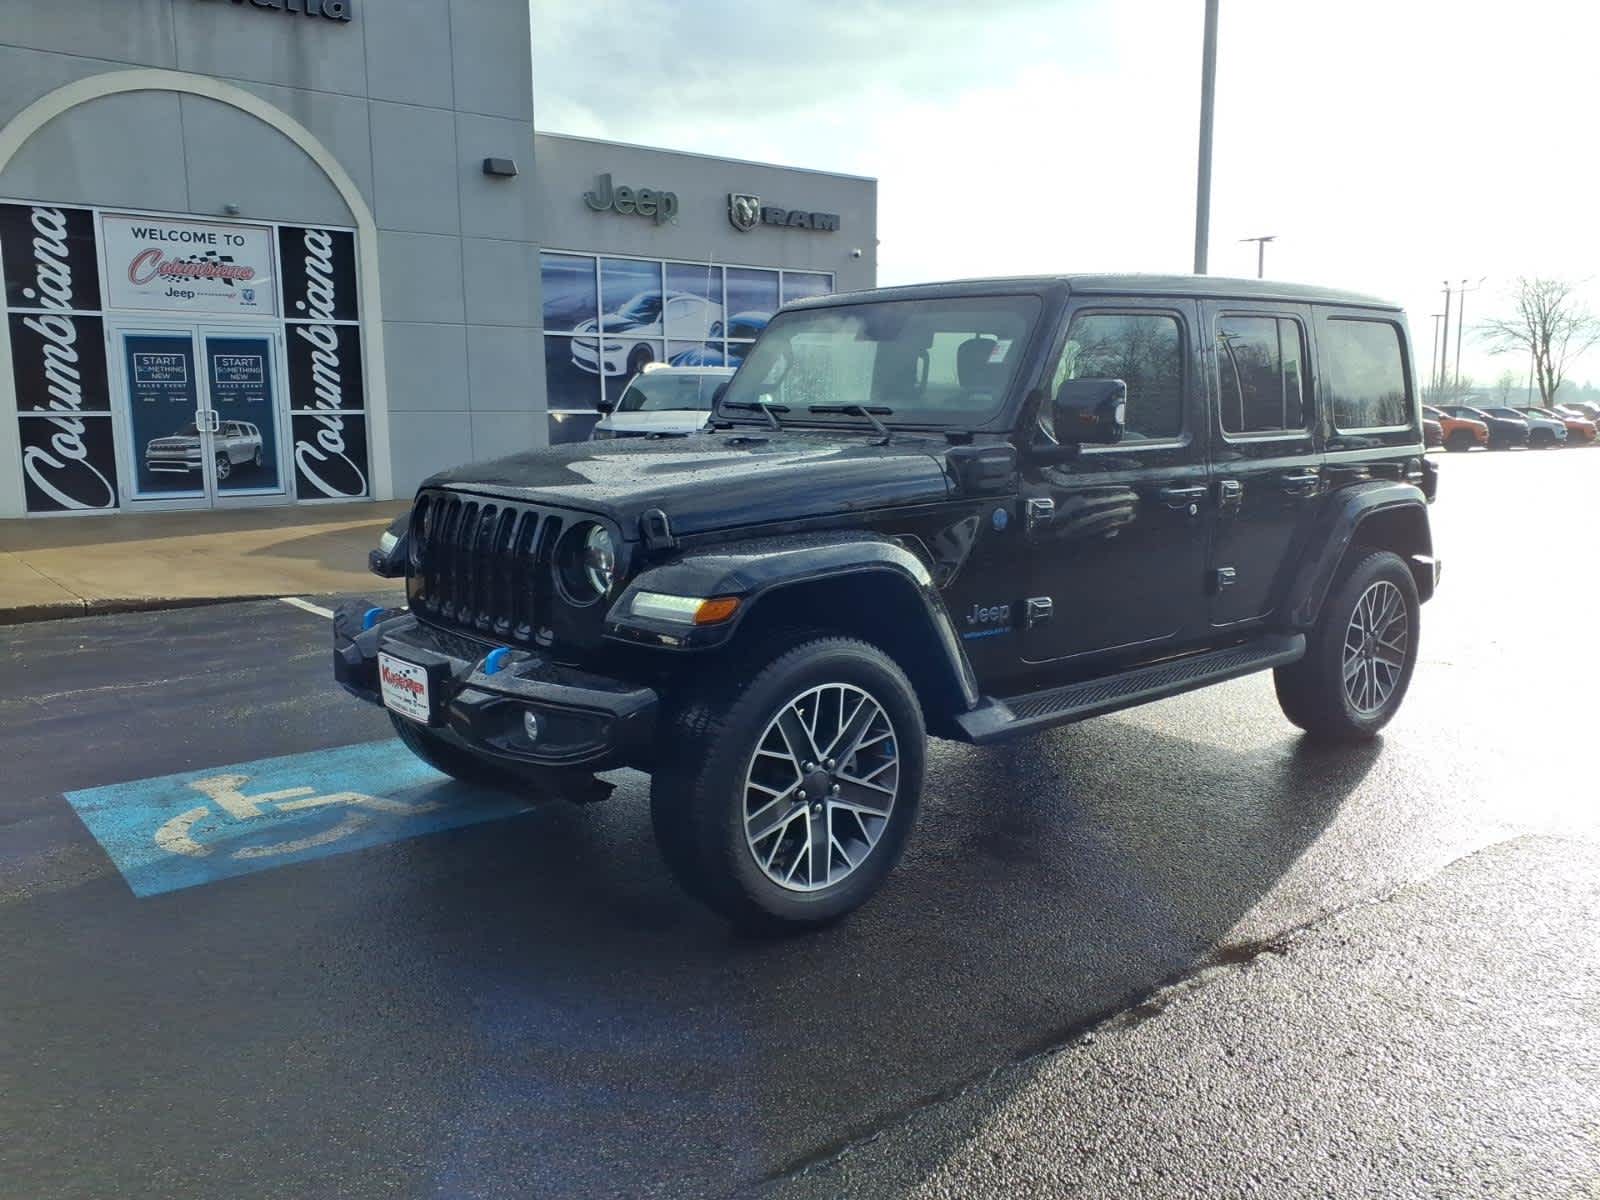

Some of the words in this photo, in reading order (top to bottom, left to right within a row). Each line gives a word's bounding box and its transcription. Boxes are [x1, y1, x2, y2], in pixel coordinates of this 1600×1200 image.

[584, 172, 679, 226] Jeep
[761, 206, 841, 232] RAM
[131, 227, 217, 245] WELCOME
[224, 234, 245, 246] TO
[164, 287, 196, 300] Jeep
[23, 206, 116, 510] Columbiana
[143, 356, 176, 365] START
[222, 359, 254, 367] START
[296, 229, 368, 499] Columbiana
[966, 603, 1009, 625] Jeep
